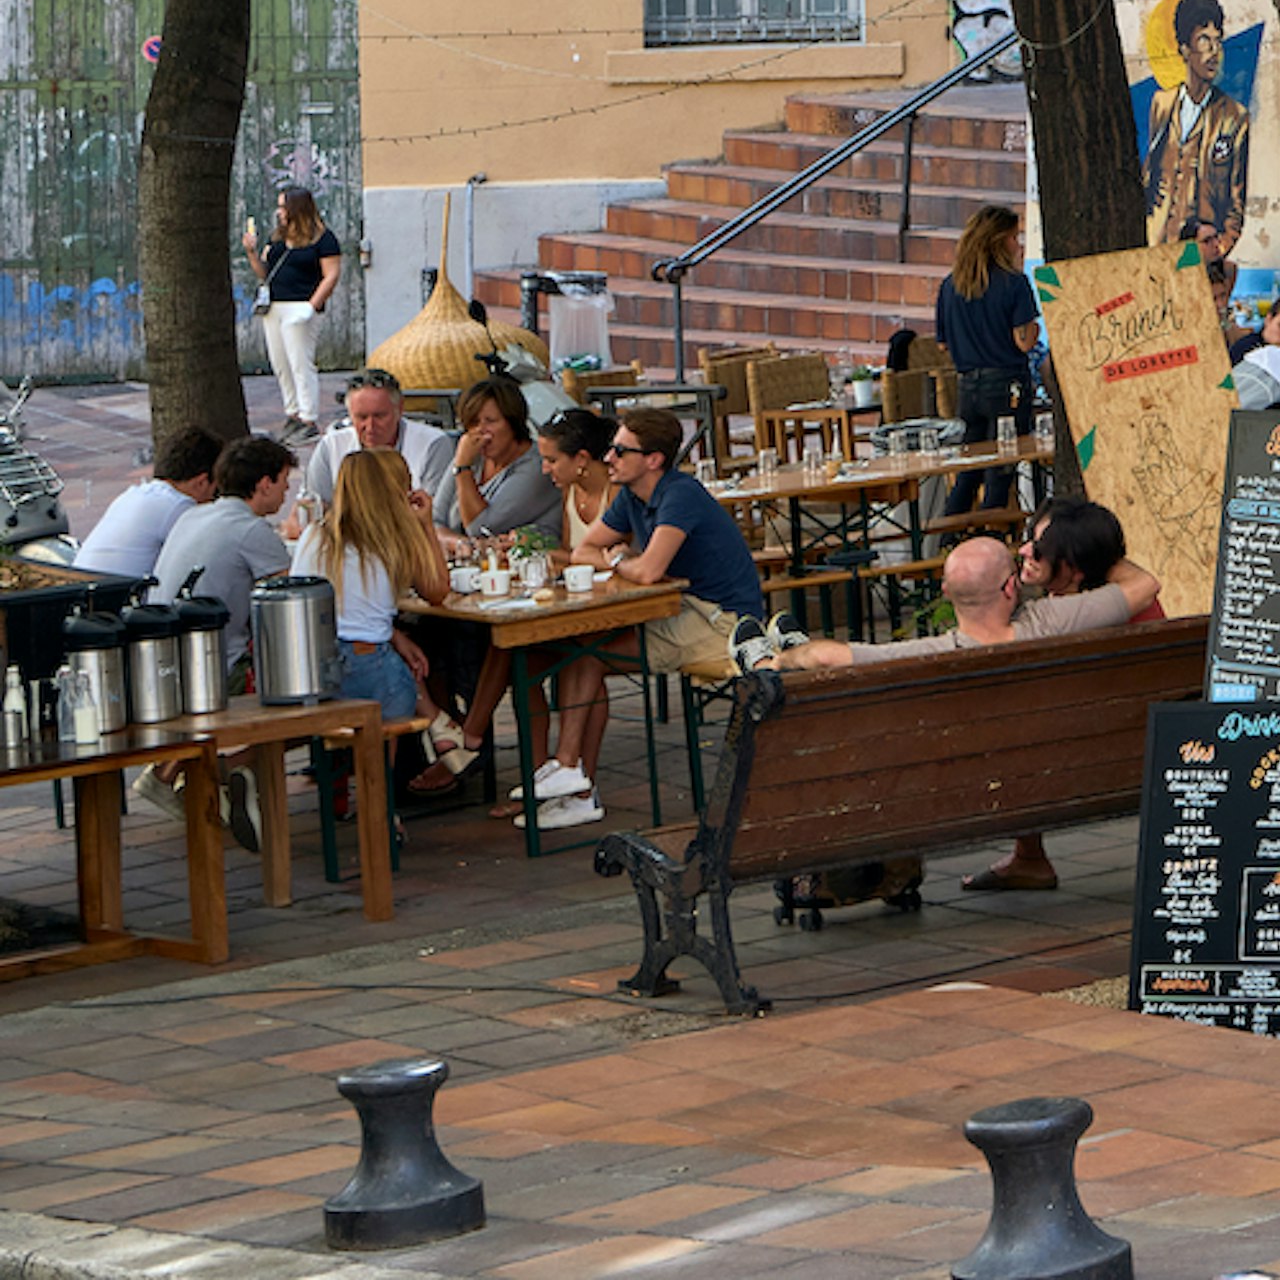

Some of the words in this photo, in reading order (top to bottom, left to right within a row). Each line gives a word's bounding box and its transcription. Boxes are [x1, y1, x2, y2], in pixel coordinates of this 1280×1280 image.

[1105, 362, 1125, 377] DE
[1130, 347, 1194, 373] LORETTE
[1164, 768, 1230, 782] BOUTEILLE
[1162, 858, 1218, 874] SPRITZ
